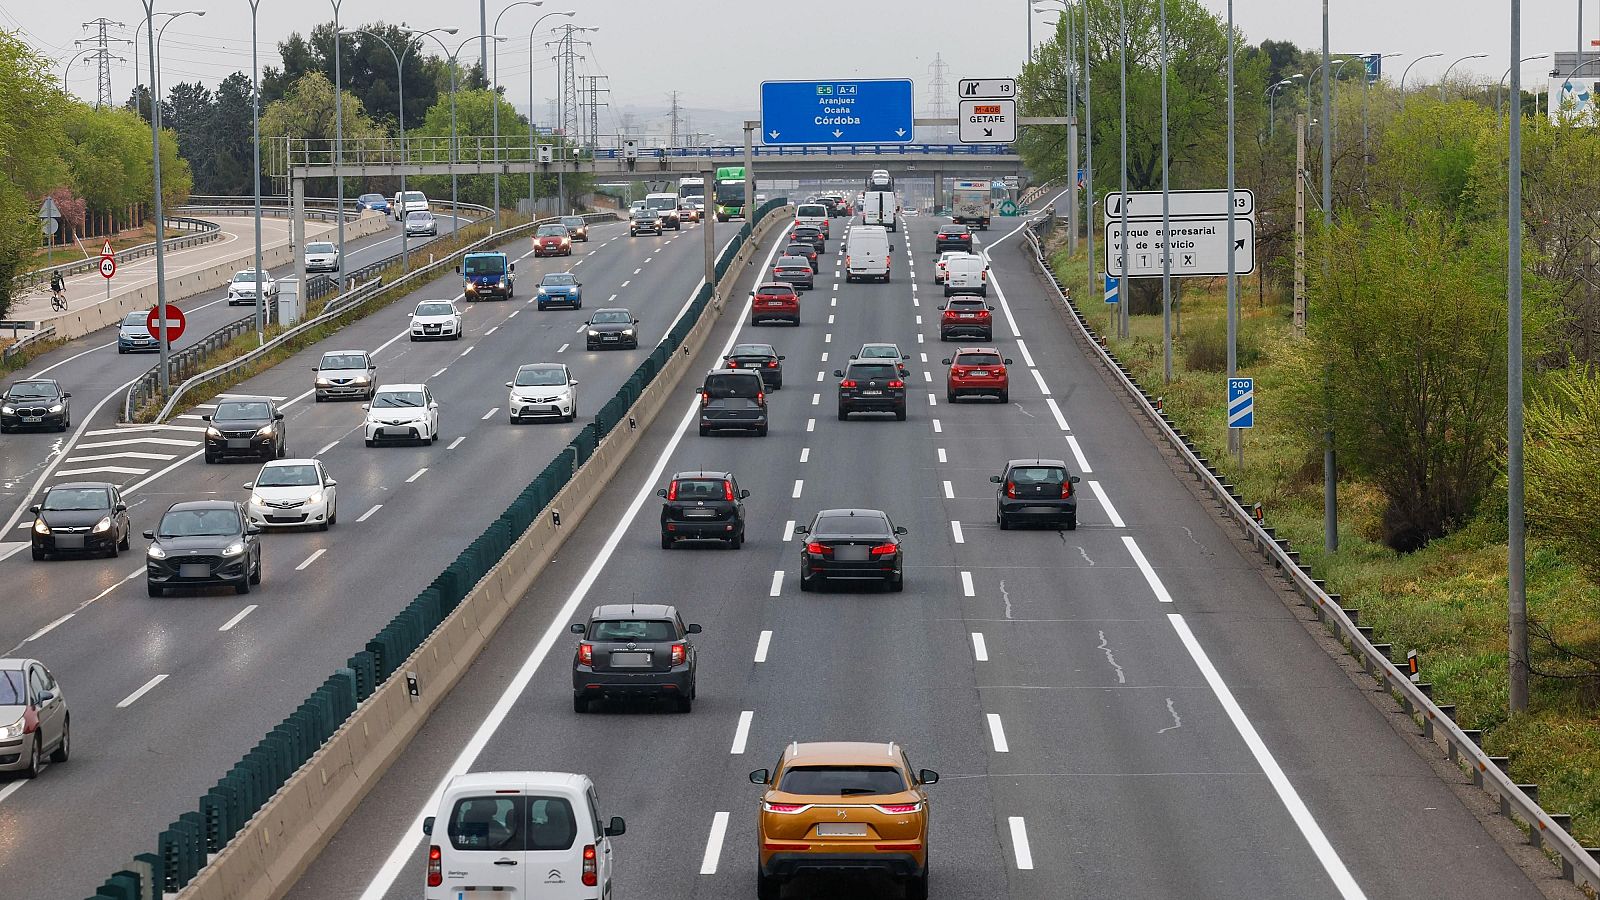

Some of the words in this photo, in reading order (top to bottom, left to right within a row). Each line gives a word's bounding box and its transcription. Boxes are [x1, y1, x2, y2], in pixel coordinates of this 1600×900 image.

[818, 86, 832, 94] E-5
[840, 86, 856, 94] A-4
[819, 97, 855, 105] Aranjuez
[824, 106, 850, 114] Ocaña
[814, 115, 861, 125] Córdoba
[969, 115, 1006, 123] GETAFE
[1234, 198, 1246, 208] 13
[1114, 230, 1149, 239] prque
[1135, 241, 1148, 250] de
[1154, 240, 1195, 249] sevicio
[102, 263, 113, 271] 40
